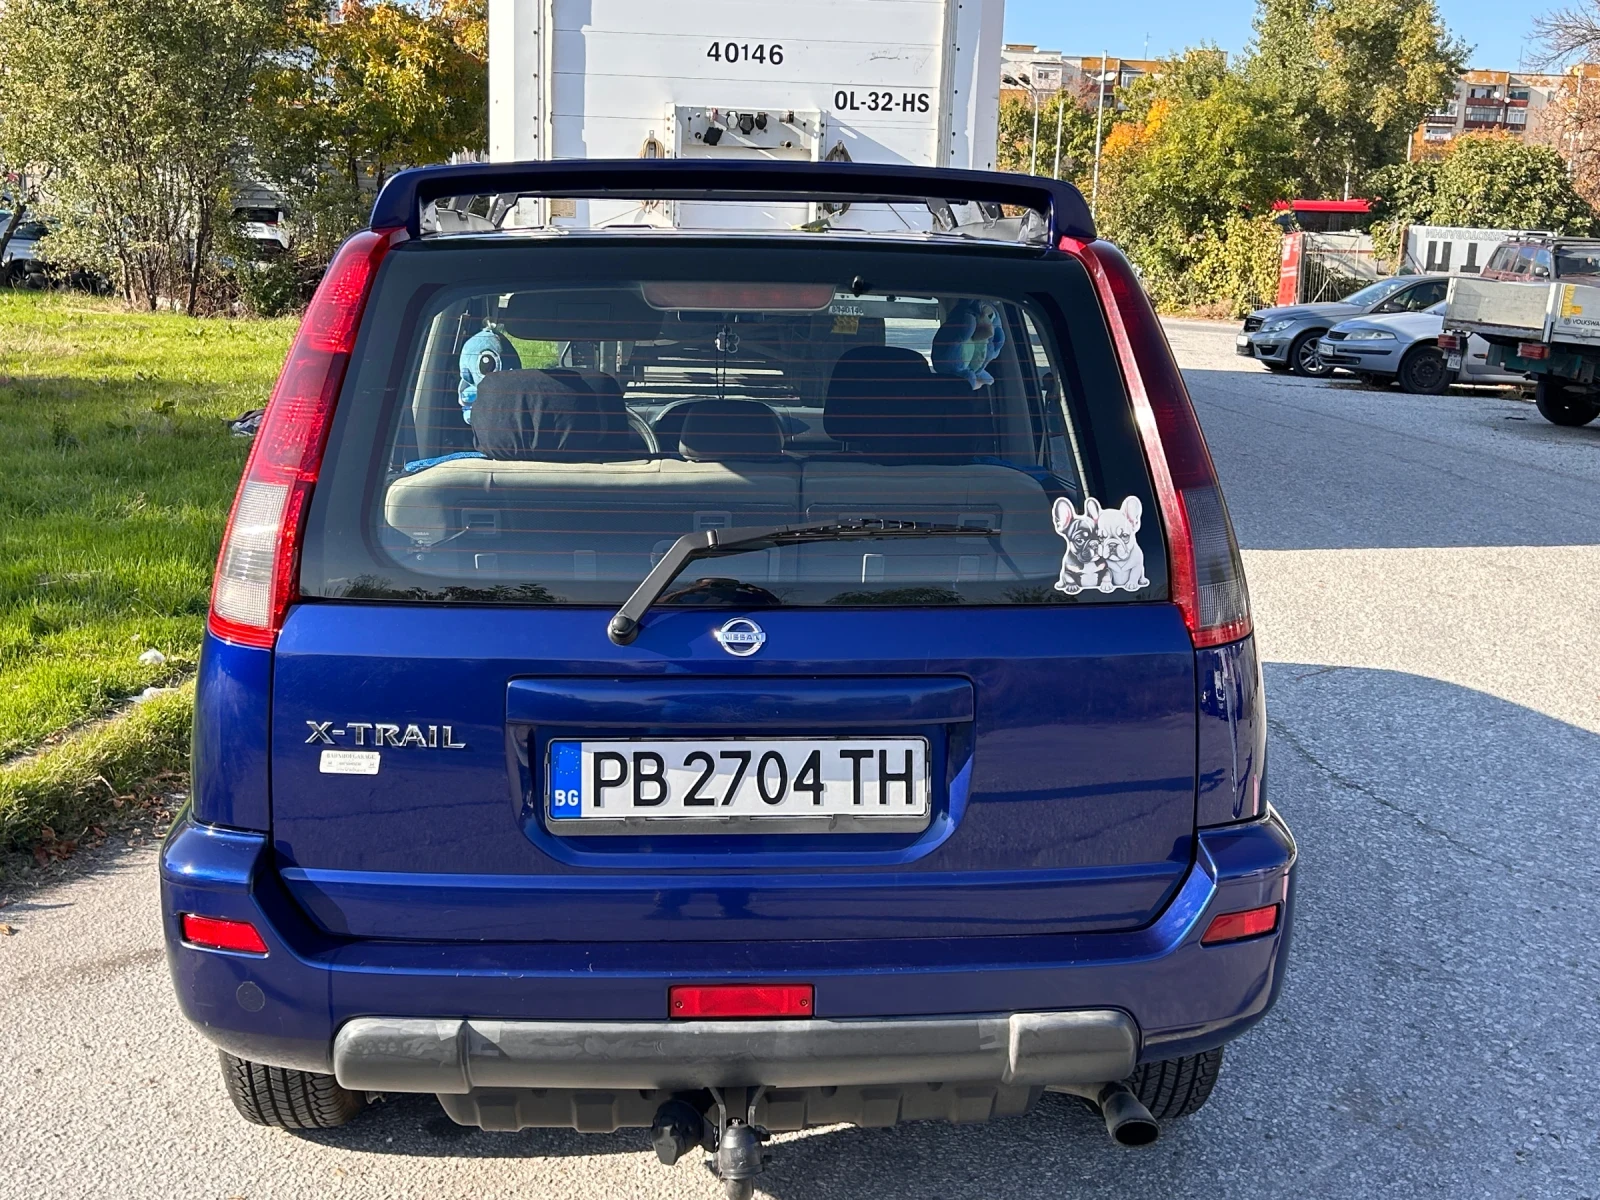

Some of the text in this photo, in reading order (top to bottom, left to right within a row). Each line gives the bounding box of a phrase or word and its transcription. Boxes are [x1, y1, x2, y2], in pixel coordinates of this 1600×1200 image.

[707, 42, 784, 65] 40146
[834, 90, 930, 113] OL-32-HS
[722, 633, 762, 641] NISSAN
[305, 720, 467, 749] X-TRAIL
[592, 749, 914, 807] PB 2704 TH
[554, 789, 579, 806] BG
